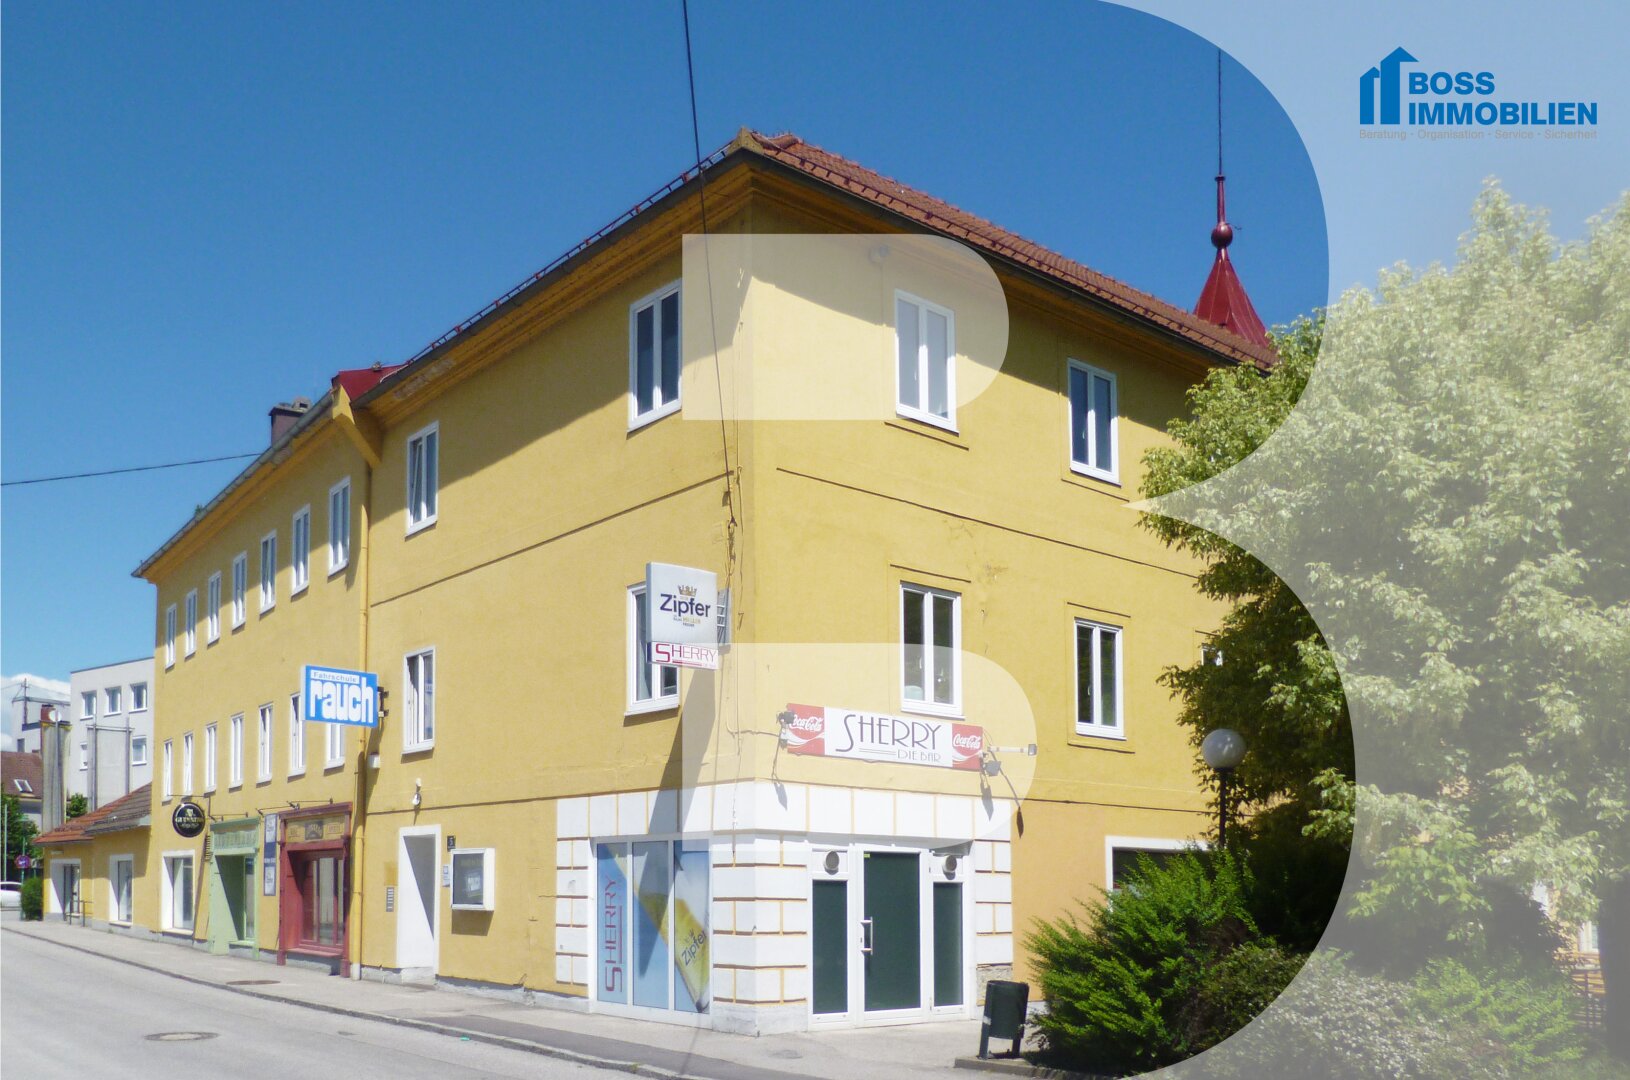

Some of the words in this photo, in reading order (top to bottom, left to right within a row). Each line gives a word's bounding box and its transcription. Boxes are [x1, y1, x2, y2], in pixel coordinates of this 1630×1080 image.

[660, 593, 711, 618] Zipfer
[655, 643, 717, 663] SHERRY
[313, 671, 357, 683] Fahrschule
[310, 676, 374, 724] rauch
[835, 714, 942, 752] SHERRY
[897, 749, 918, 761] DIE
[920, 751, 942, 763] BAR
[604, 880, 623, 992] SHERRY
[681, 930, 707, 966] Zipfer
